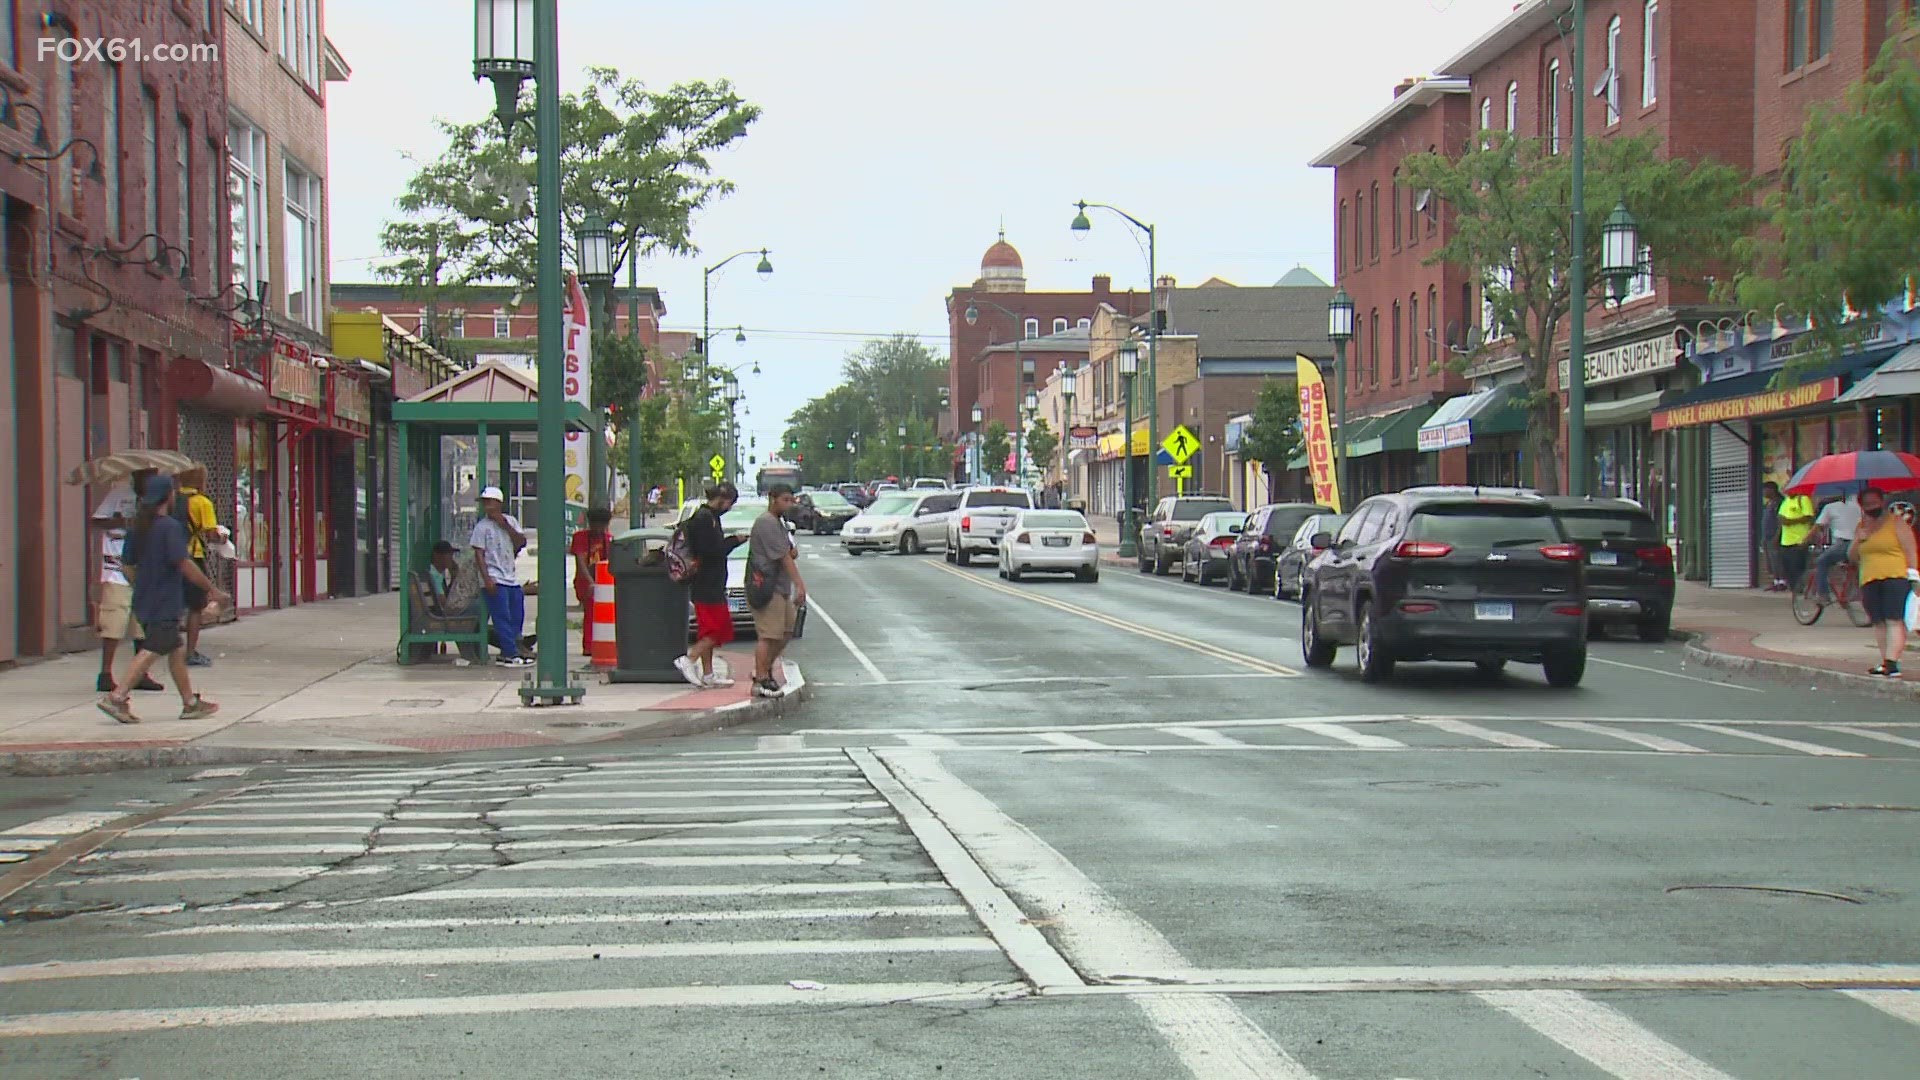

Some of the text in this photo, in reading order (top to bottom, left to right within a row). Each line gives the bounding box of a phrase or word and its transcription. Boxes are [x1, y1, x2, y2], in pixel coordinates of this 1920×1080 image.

[1584, 350, 1620, 381] BEAUTY
[1623, 340, 1662, 373] SUPPLY
[1667, 384, 1822, 427] ANGEL GROCERY SMOKE SHOP
